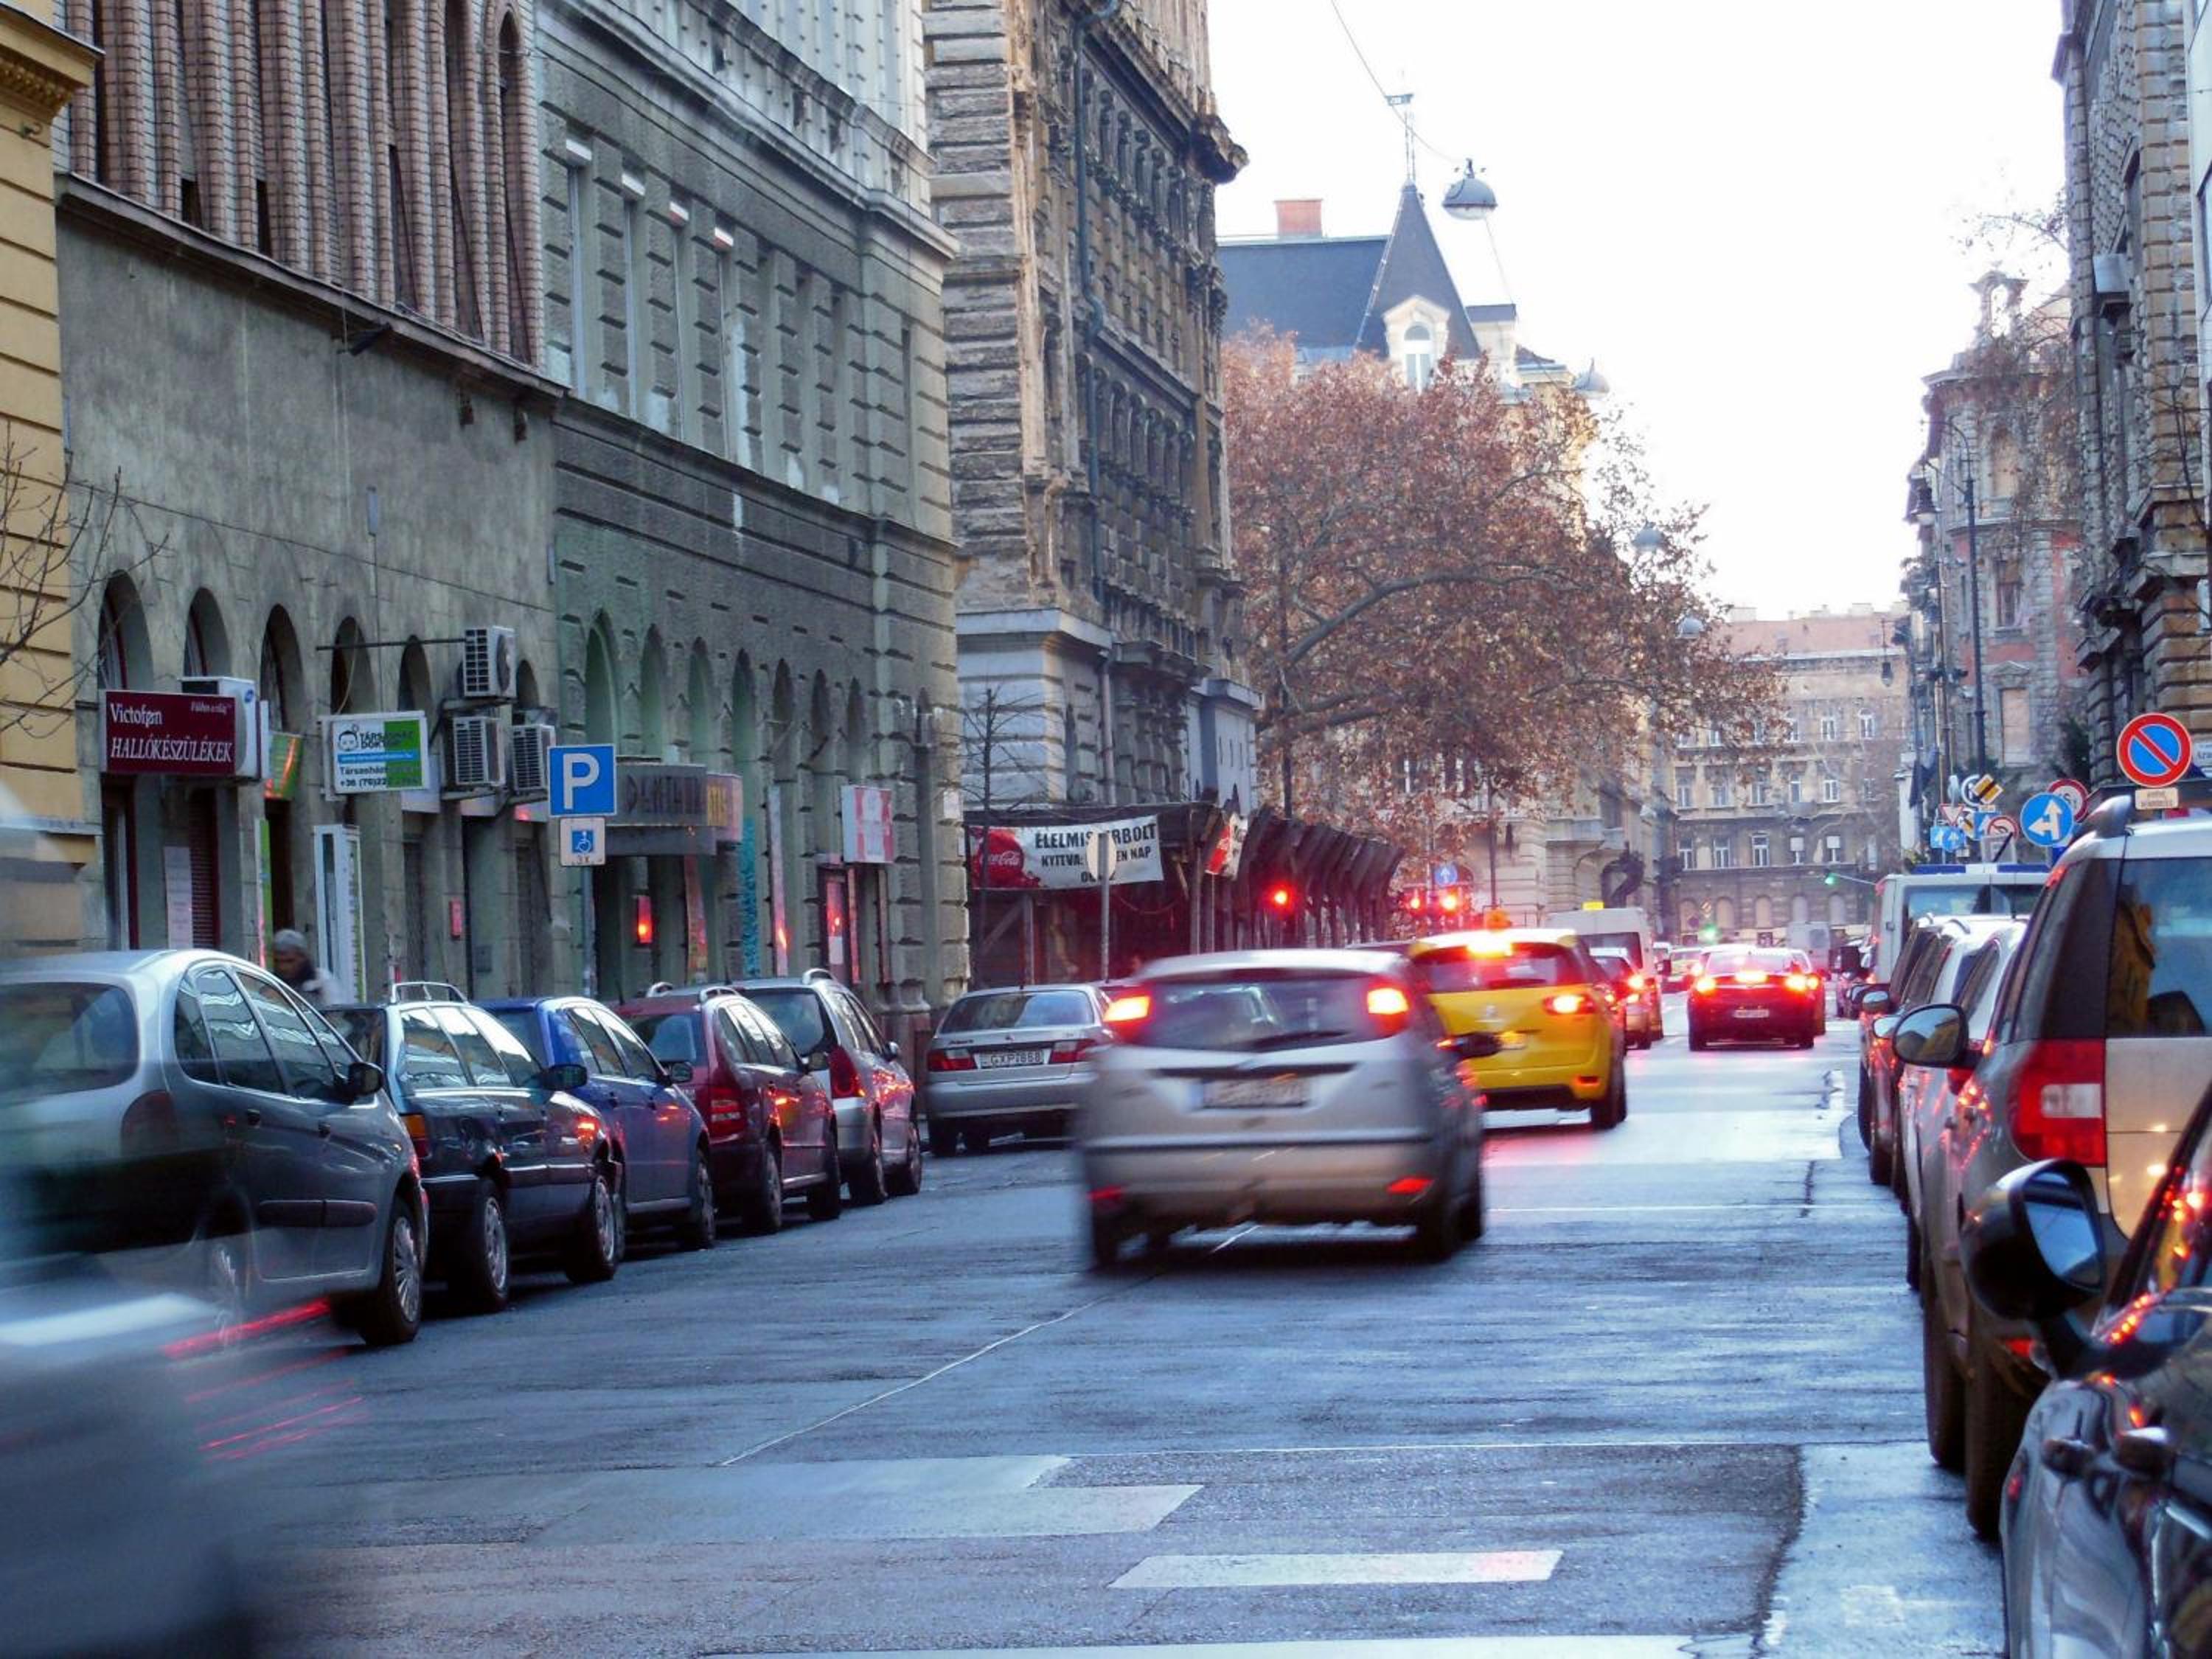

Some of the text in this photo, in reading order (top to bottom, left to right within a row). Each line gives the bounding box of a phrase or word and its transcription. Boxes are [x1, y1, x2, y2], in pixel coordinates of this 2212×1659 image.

[111, 734, 233, 762] HALLÓKÉSZÜLÉKEK
[563, 754, 599, 810] P
[1035, 823, 1157, 849] ÉLELMISRBOLT
